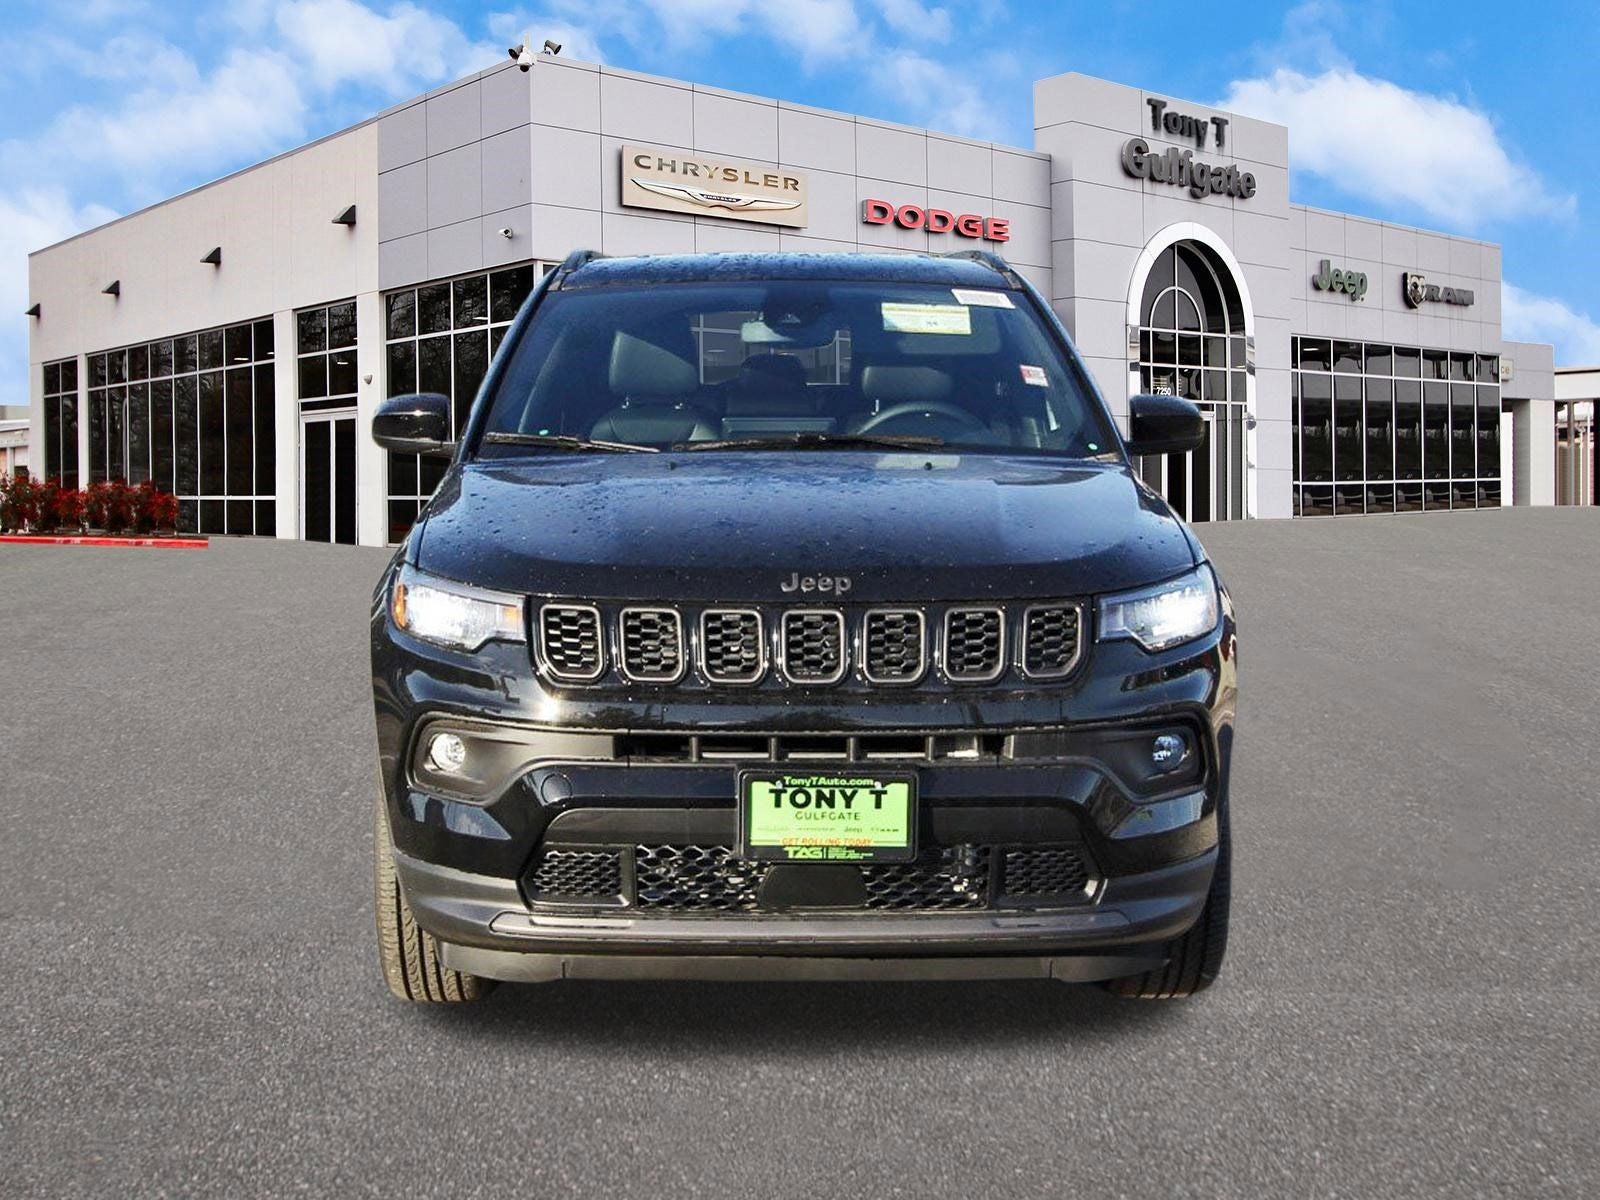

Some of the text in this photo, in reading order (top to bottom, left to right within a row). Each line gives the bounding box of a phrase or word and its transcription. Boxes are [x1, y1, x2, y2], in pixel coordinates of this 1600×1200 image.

[1146, 98, 1229, 147] Tony T
[633, 153, 801, 192] CHRYSLER
[1122, 138, 1257, 199] Gulfgate
[862, 198, 1011, 242] DODGE
[1313, 259, 1368, 301] Jeep
[1424, 284, 1475, 307] RAM
[780, 572, 852, 596] Jeep
[783, 775, 874, 787] TonyTAuto.com
[769, 788, 888, 809] TONY T
[795, 811, 861, 821] GULFGATE
[784, 847, 822, 859] TAG
